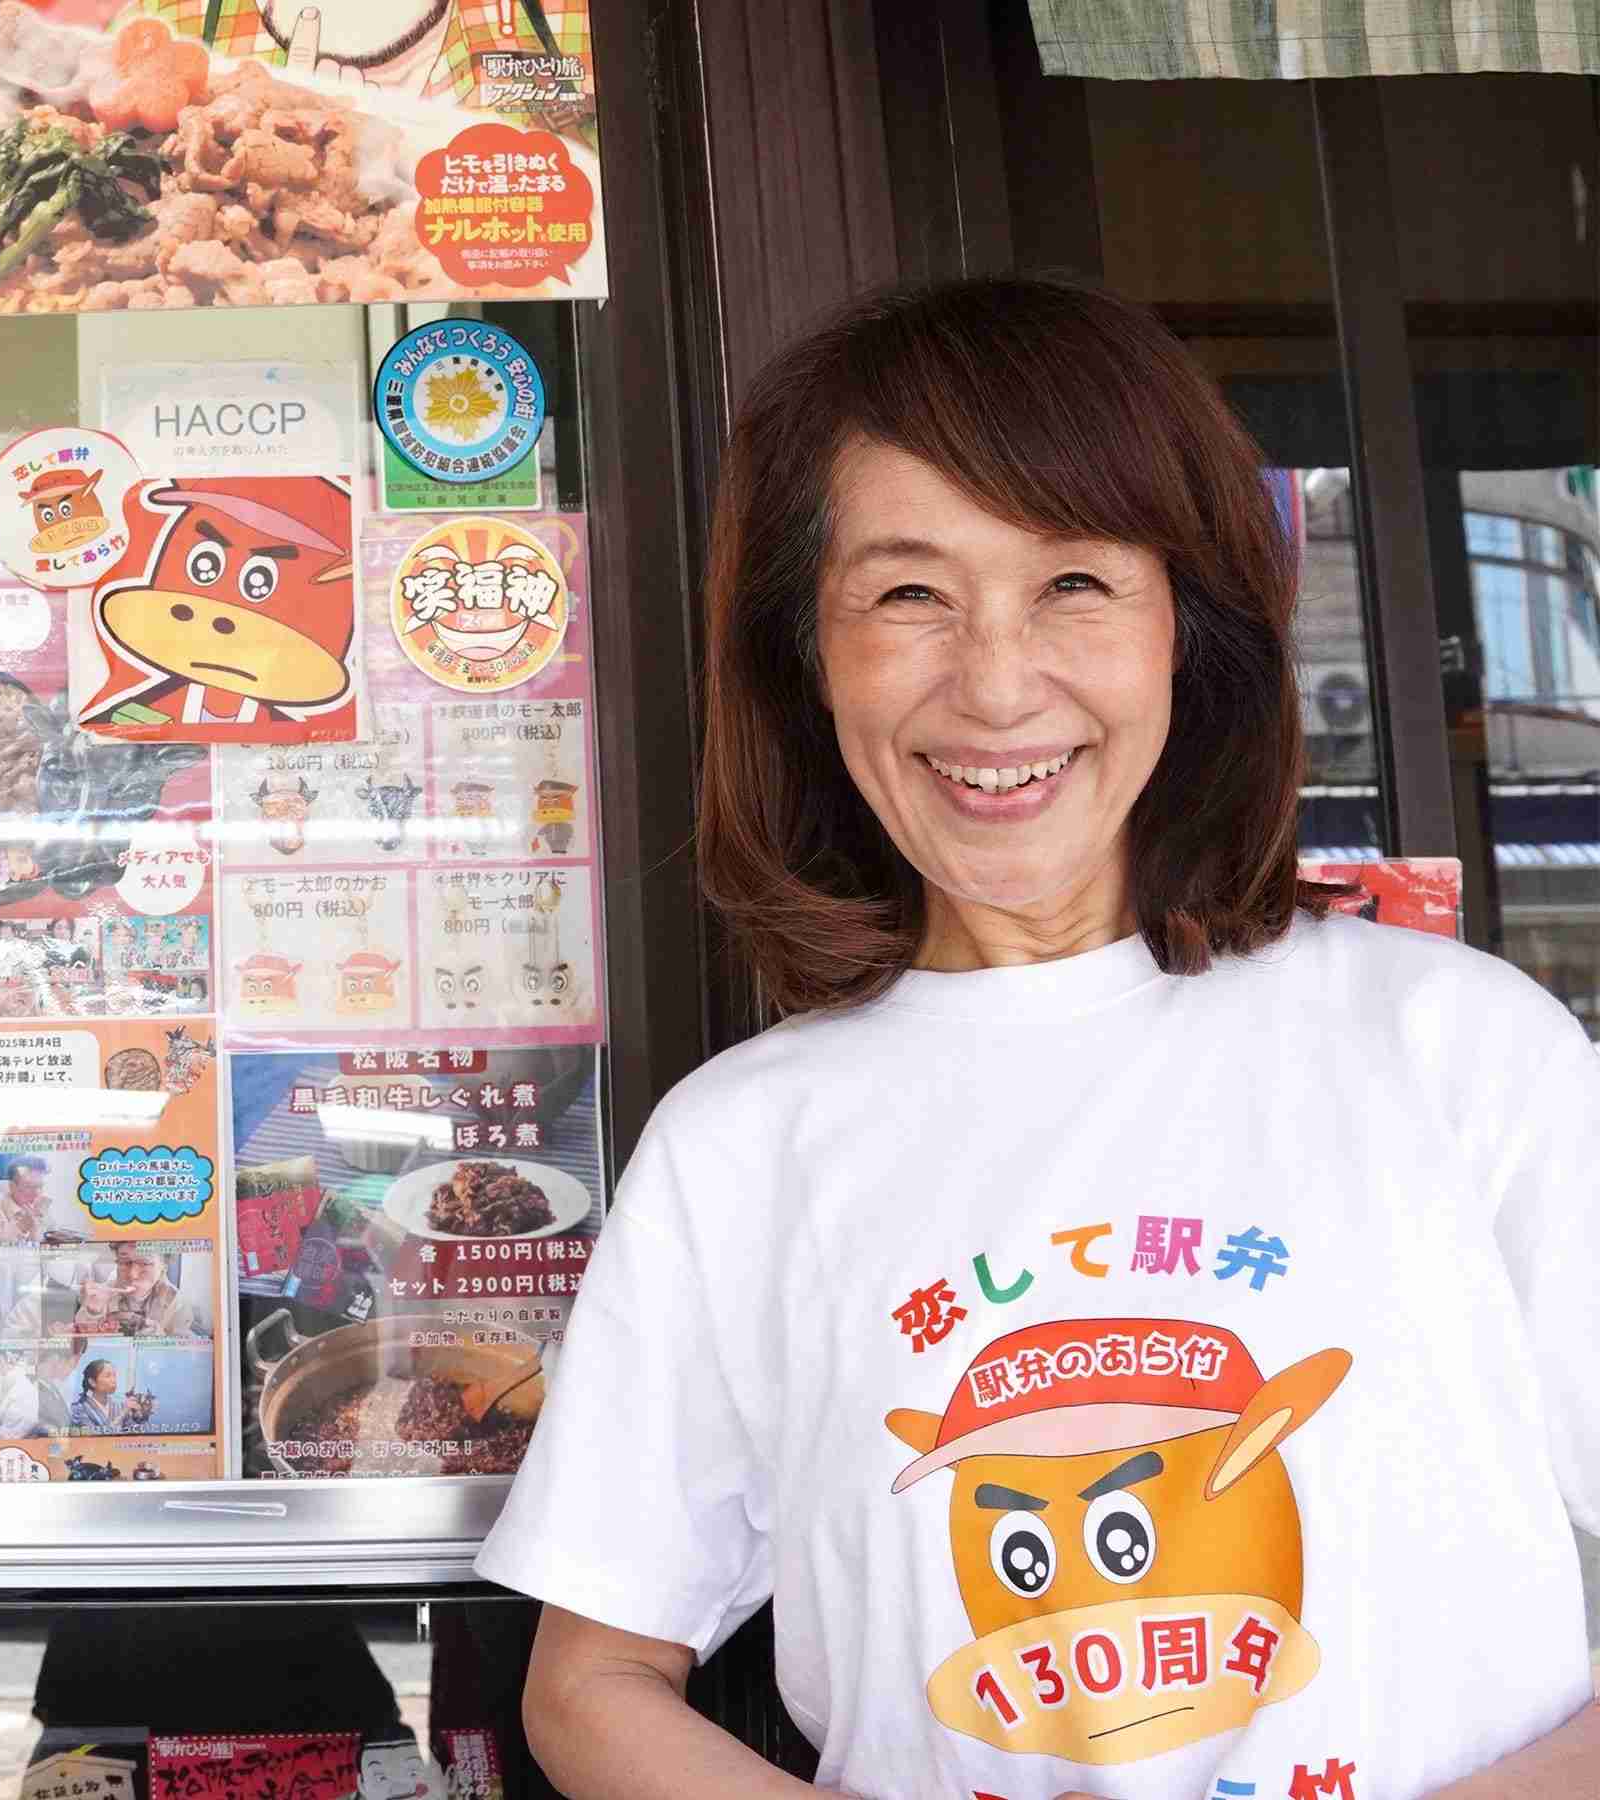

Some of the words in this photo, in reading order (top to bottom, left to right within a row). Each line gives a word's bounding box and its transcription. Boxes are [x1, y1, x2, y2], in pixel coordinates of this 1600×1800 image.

[444, 154, 559, 174] ヒモを引きぬく
[440, 175, 567, 195] だけで温ったまる
[153, 402, 307, 439] HACCP
[141, 873, 188, 890] 大人気
[468, 894, 535, 910] モー太郎
[353, 1048, 475, 1070] 松阪名物
[292, 1083, 537, 1113] 黒毛和牛しぐれ煮
[419, 1244, 438, 1263] 各
[388, 1277, 446, 1296] セット
[891, 1214, 1292, 1354] 恋して駅弁
[443, 1308, 562, 1324] こだわりの自家製
[970, 1331, 1230, 1409] 駅弁のあら竹
[973, 1614, 1282, 1728] 130周年
